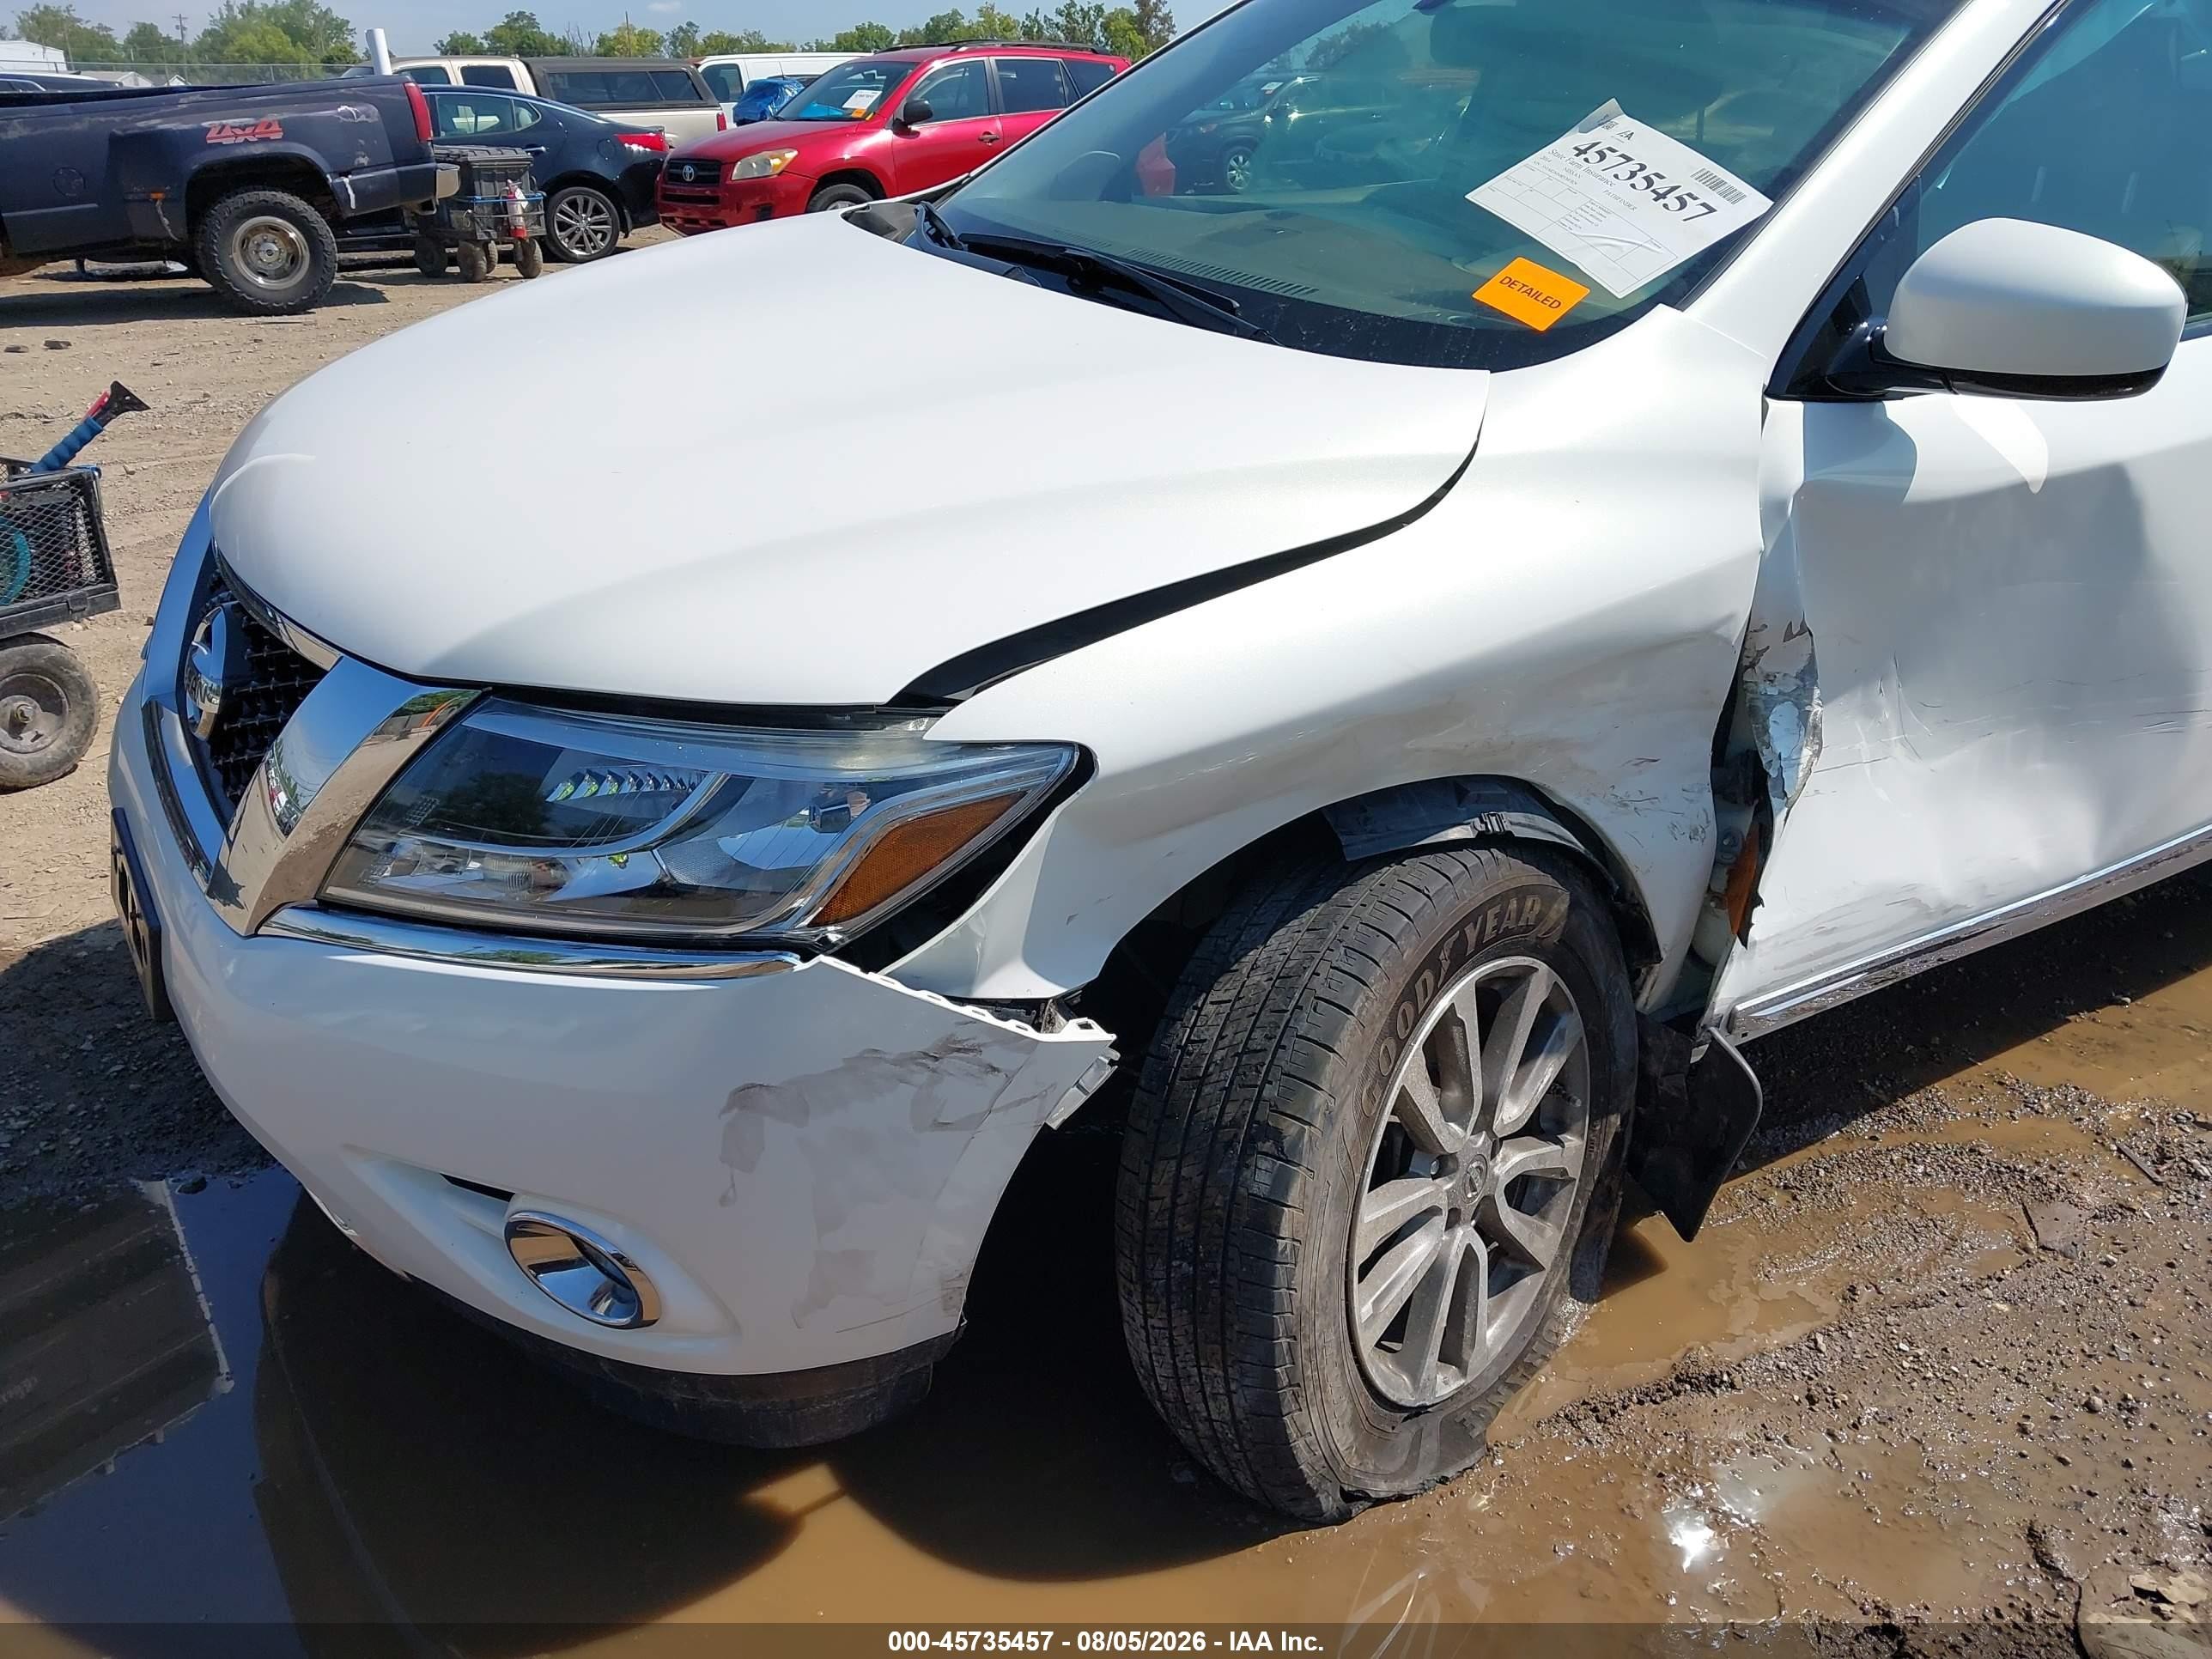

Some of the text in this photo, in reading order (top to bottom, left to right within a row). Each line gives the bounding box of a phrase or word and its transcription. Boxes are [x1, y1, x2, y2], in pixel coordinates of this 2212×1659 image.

[1548, 149, 1566, 161] State
[1565, 155, 1583, 171] Farm
[1583, 165, 1617, 187] Insurance
[1572, 141, 1717, 222] 45735457
[1499, 275, 1562, 310] DETAILED
